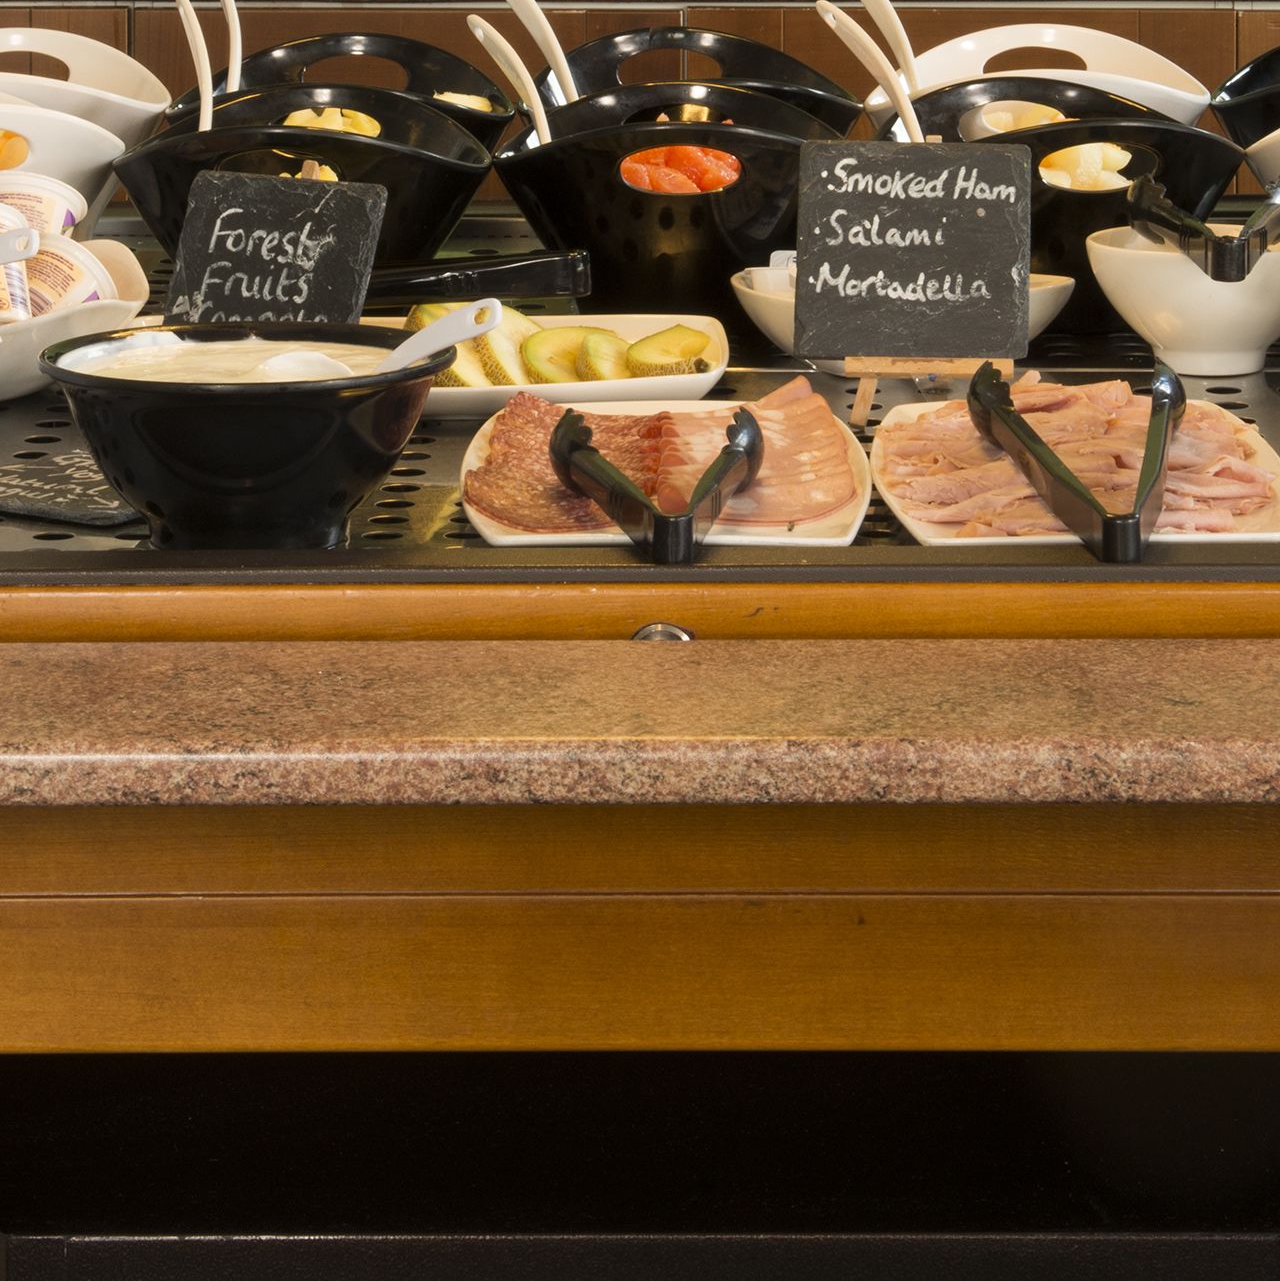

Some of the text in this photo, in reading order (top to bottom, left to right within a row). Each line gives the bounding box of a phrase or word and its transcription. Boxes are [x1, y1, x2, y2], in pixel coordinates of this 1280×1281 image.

[827, 157, 1017, 204] Smoked Ham
[208, 207, 320, 271] Forest
[825, 208, 946, 247] Salami
[200, 261, 314, 305] Fruits
[815, 261, 992, 303] Mortadella
